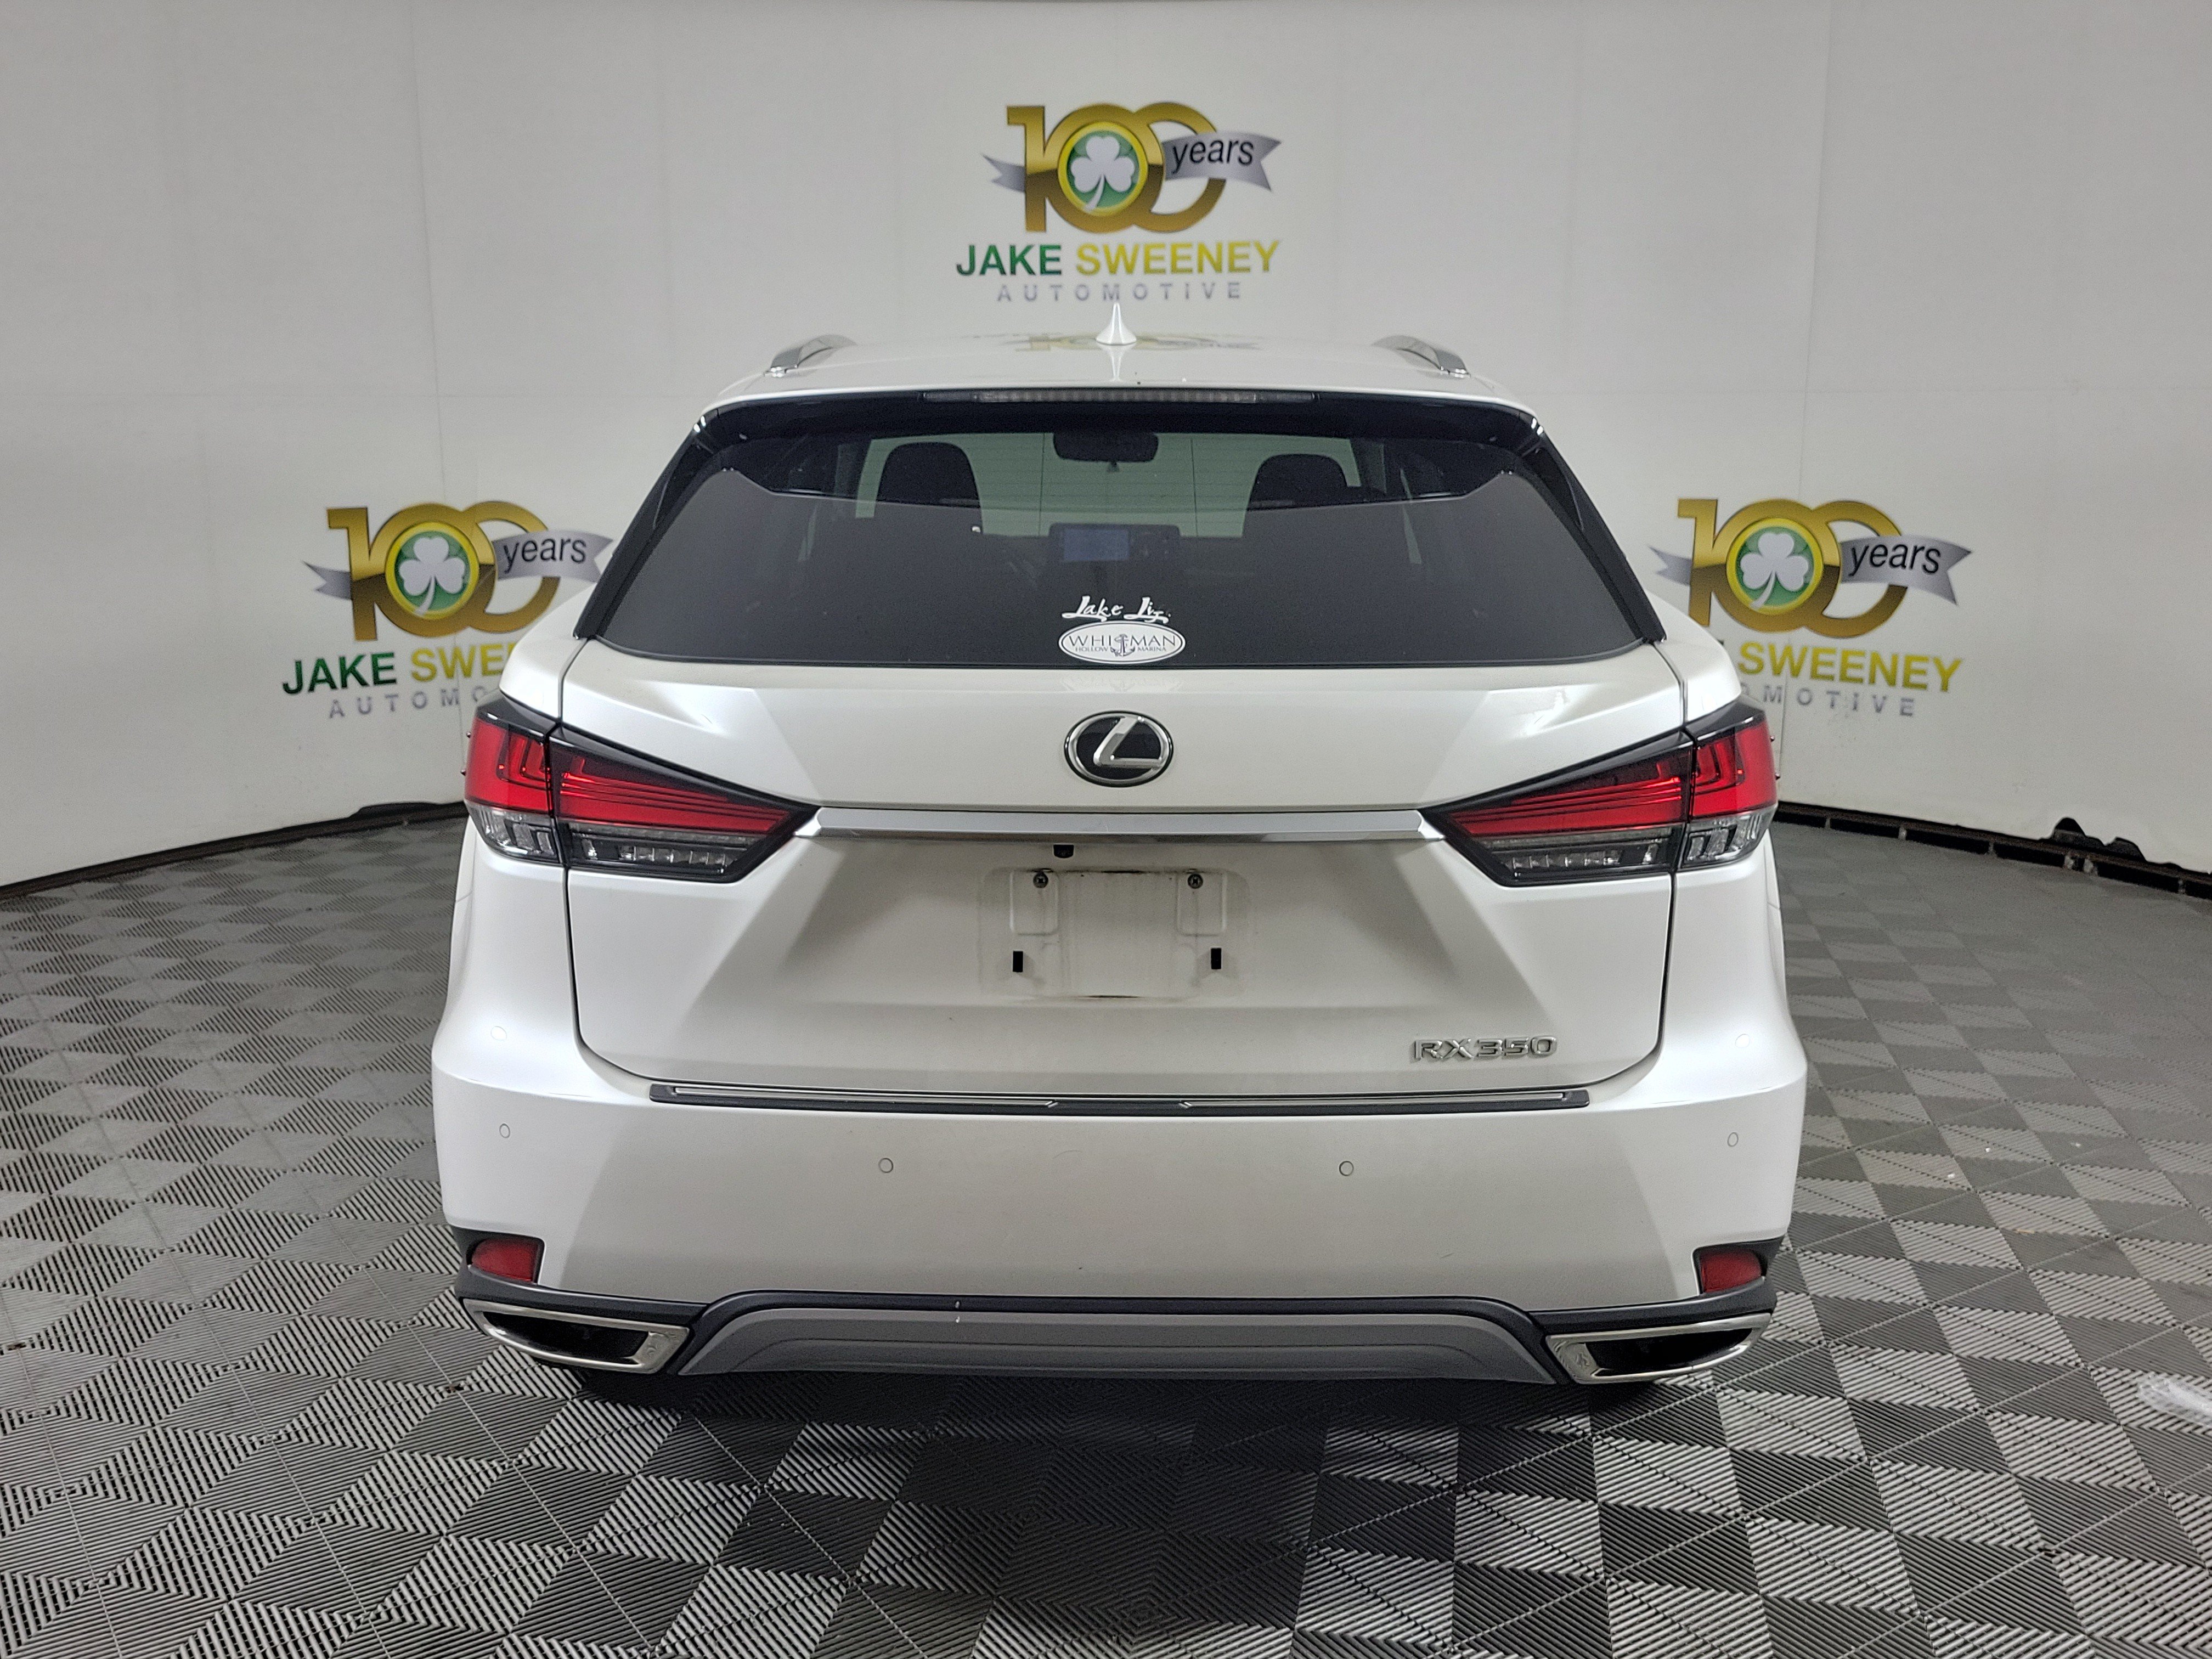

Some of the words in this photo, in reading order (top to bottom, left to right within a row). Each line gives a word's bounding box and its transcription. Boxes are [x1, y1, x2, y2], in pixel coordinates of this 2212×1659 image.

[1006, 101, 1227, 233] 100
[1172, 138, 1255, 174] years
[956, 243, 1063, 276] JAKE
[1075, 239, 1280, 276] SWEENEY
[997, 280, 1241, 302] AUTOMOTIVE
[326, 500, 560, 641] 100
[502, 534, 586, 574] years
[1677, 498, 1909, 638] 100
[1849, 542, 1942, 577] years
[1062, 595, 1124, 622] Lake
[282, 652, 397, 695] JAKE
[1737, 641, 1962, 693] SWEENEY
